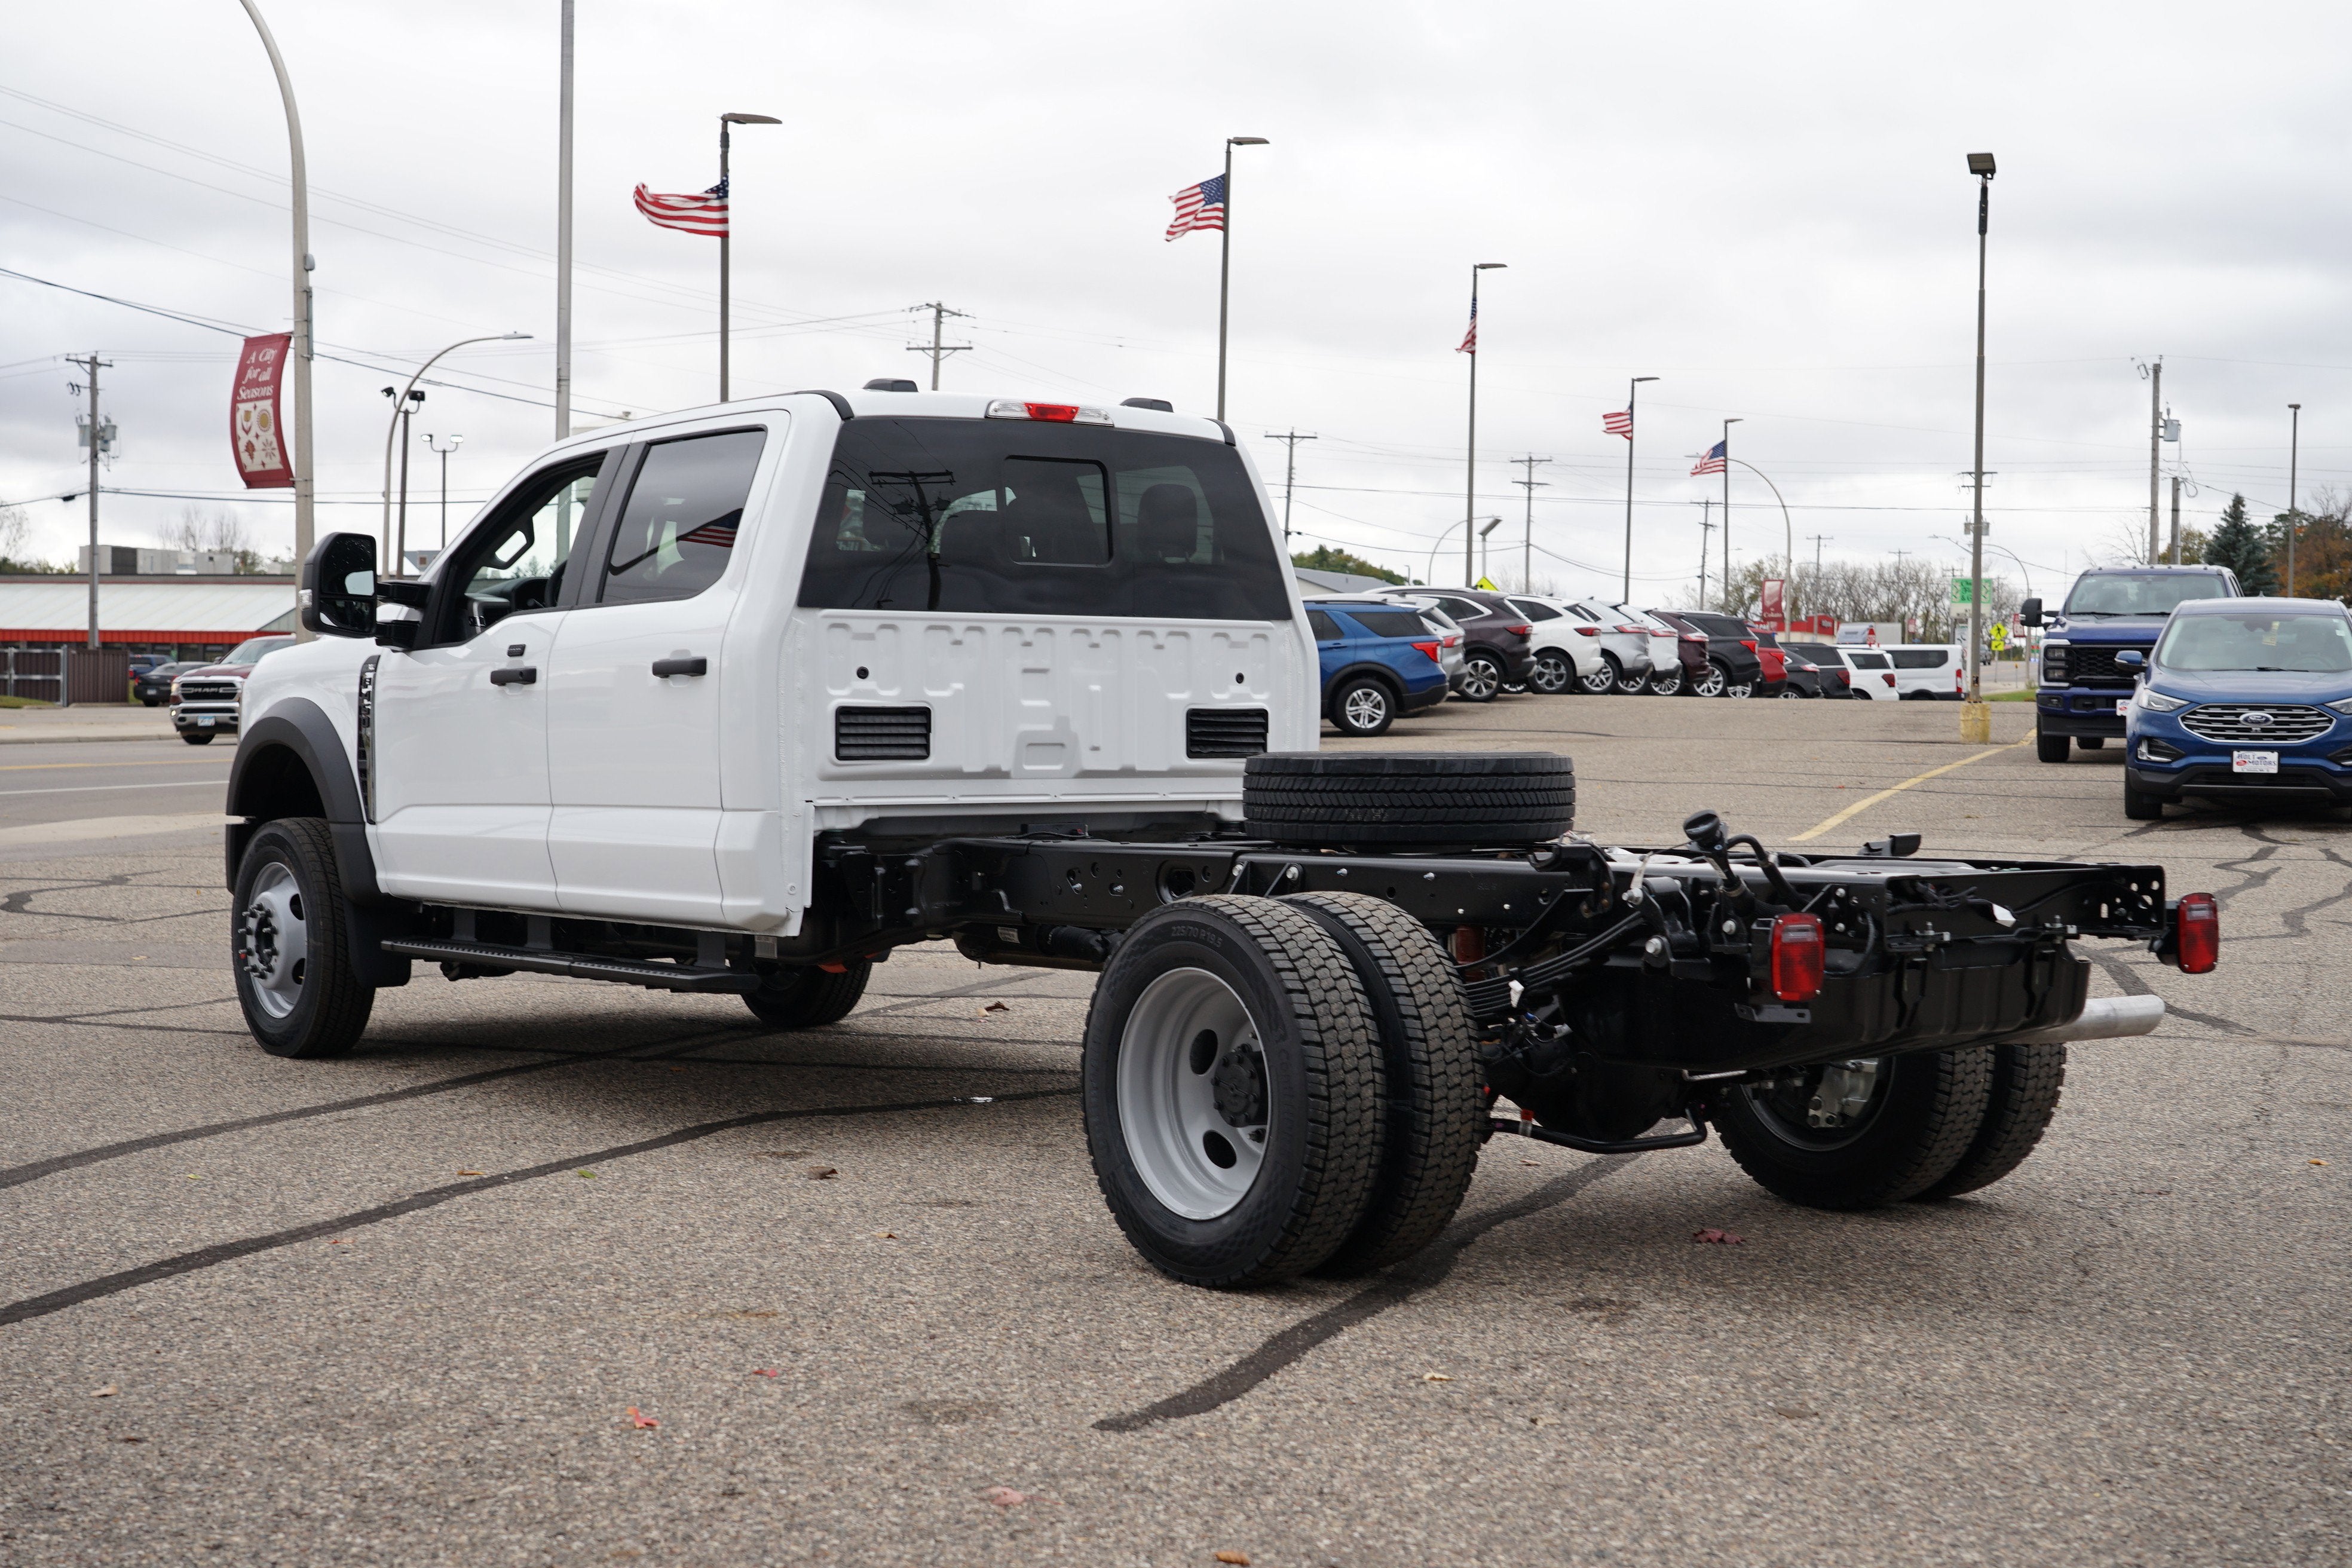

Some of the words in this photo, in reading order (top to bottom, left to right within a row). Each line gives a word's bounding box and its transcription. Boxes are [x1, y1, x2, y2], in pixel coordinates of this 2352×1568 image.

[246, 351, 256, 364] A
[259, 348, 277, 365] City
[242, 366, 261, 384] for
[258, 366, 272, 382] all
[237, 384, 274, 400] Seasons
[1171, 926, 1199, 937] 225/70
